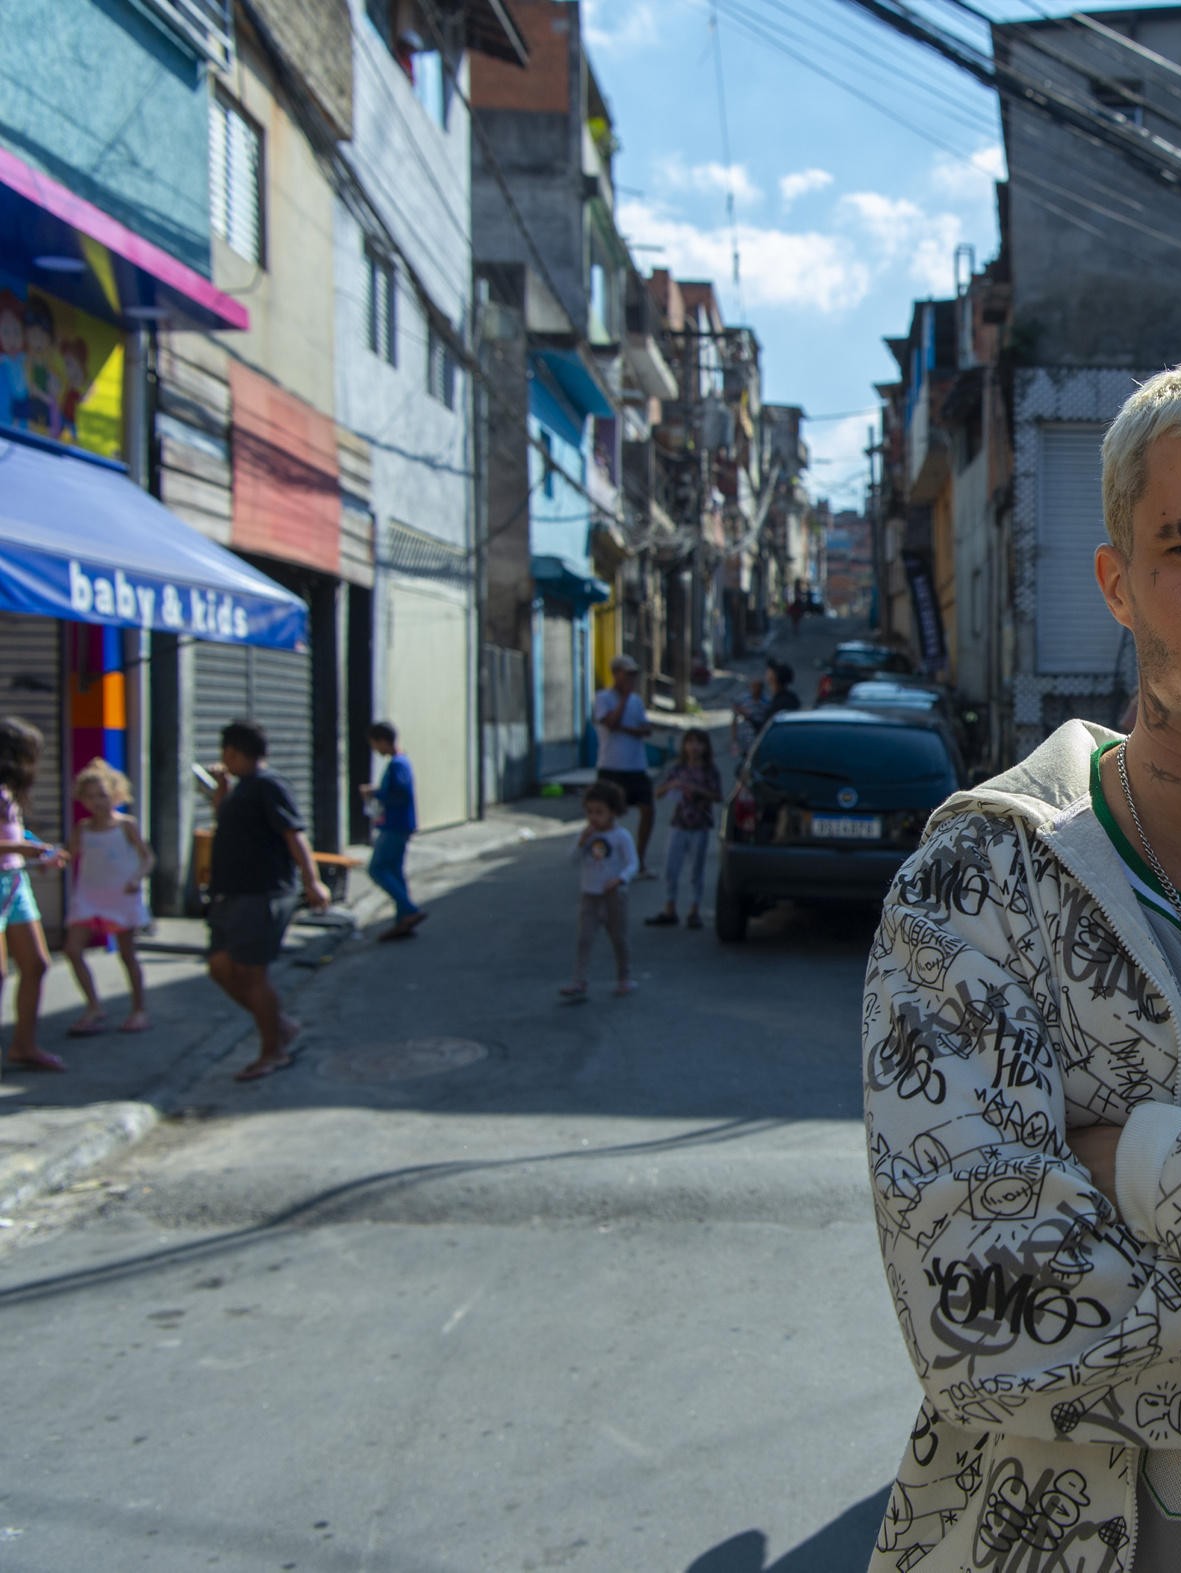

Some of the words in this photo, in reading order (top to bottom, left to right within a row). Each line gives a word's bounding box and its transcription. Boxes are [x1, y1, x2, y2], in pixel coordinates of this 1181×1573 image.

[70, 559, 156, 628] baby
[162, 583, 184, 628] &
[190, 588, 249, 638] kids
